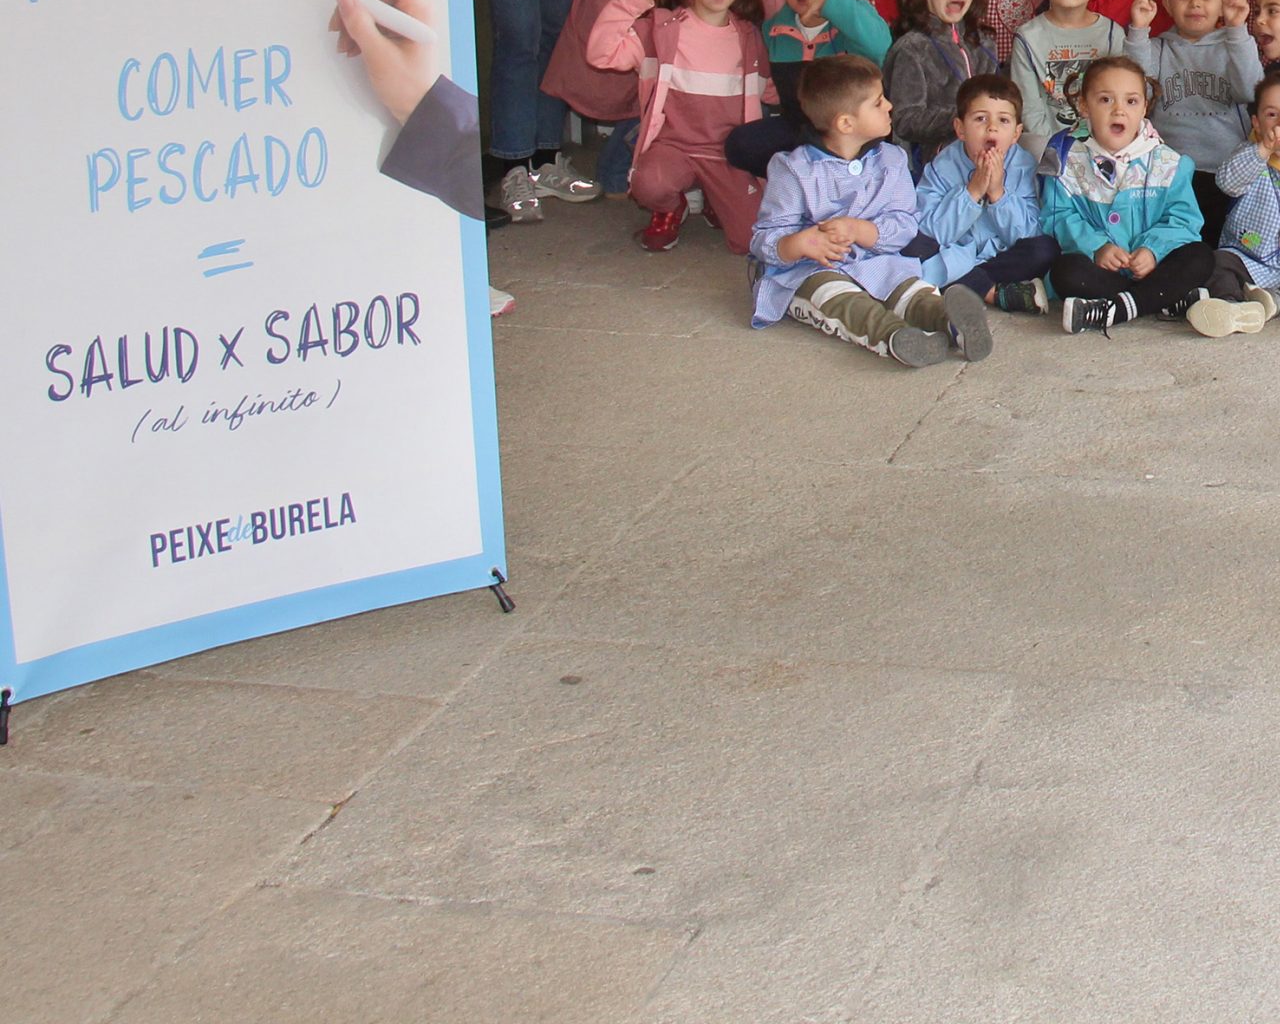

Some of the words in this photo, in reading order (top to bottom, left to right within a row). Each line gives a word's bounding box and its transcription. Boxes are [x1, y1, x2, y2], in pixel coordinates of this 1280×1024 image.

[118, 45, 293, 121] COMER
[87, 127, 328, 213] PESCADO
[45, 326, 199, 402] SALUD
[265, 292, 421, 364] SABOR
